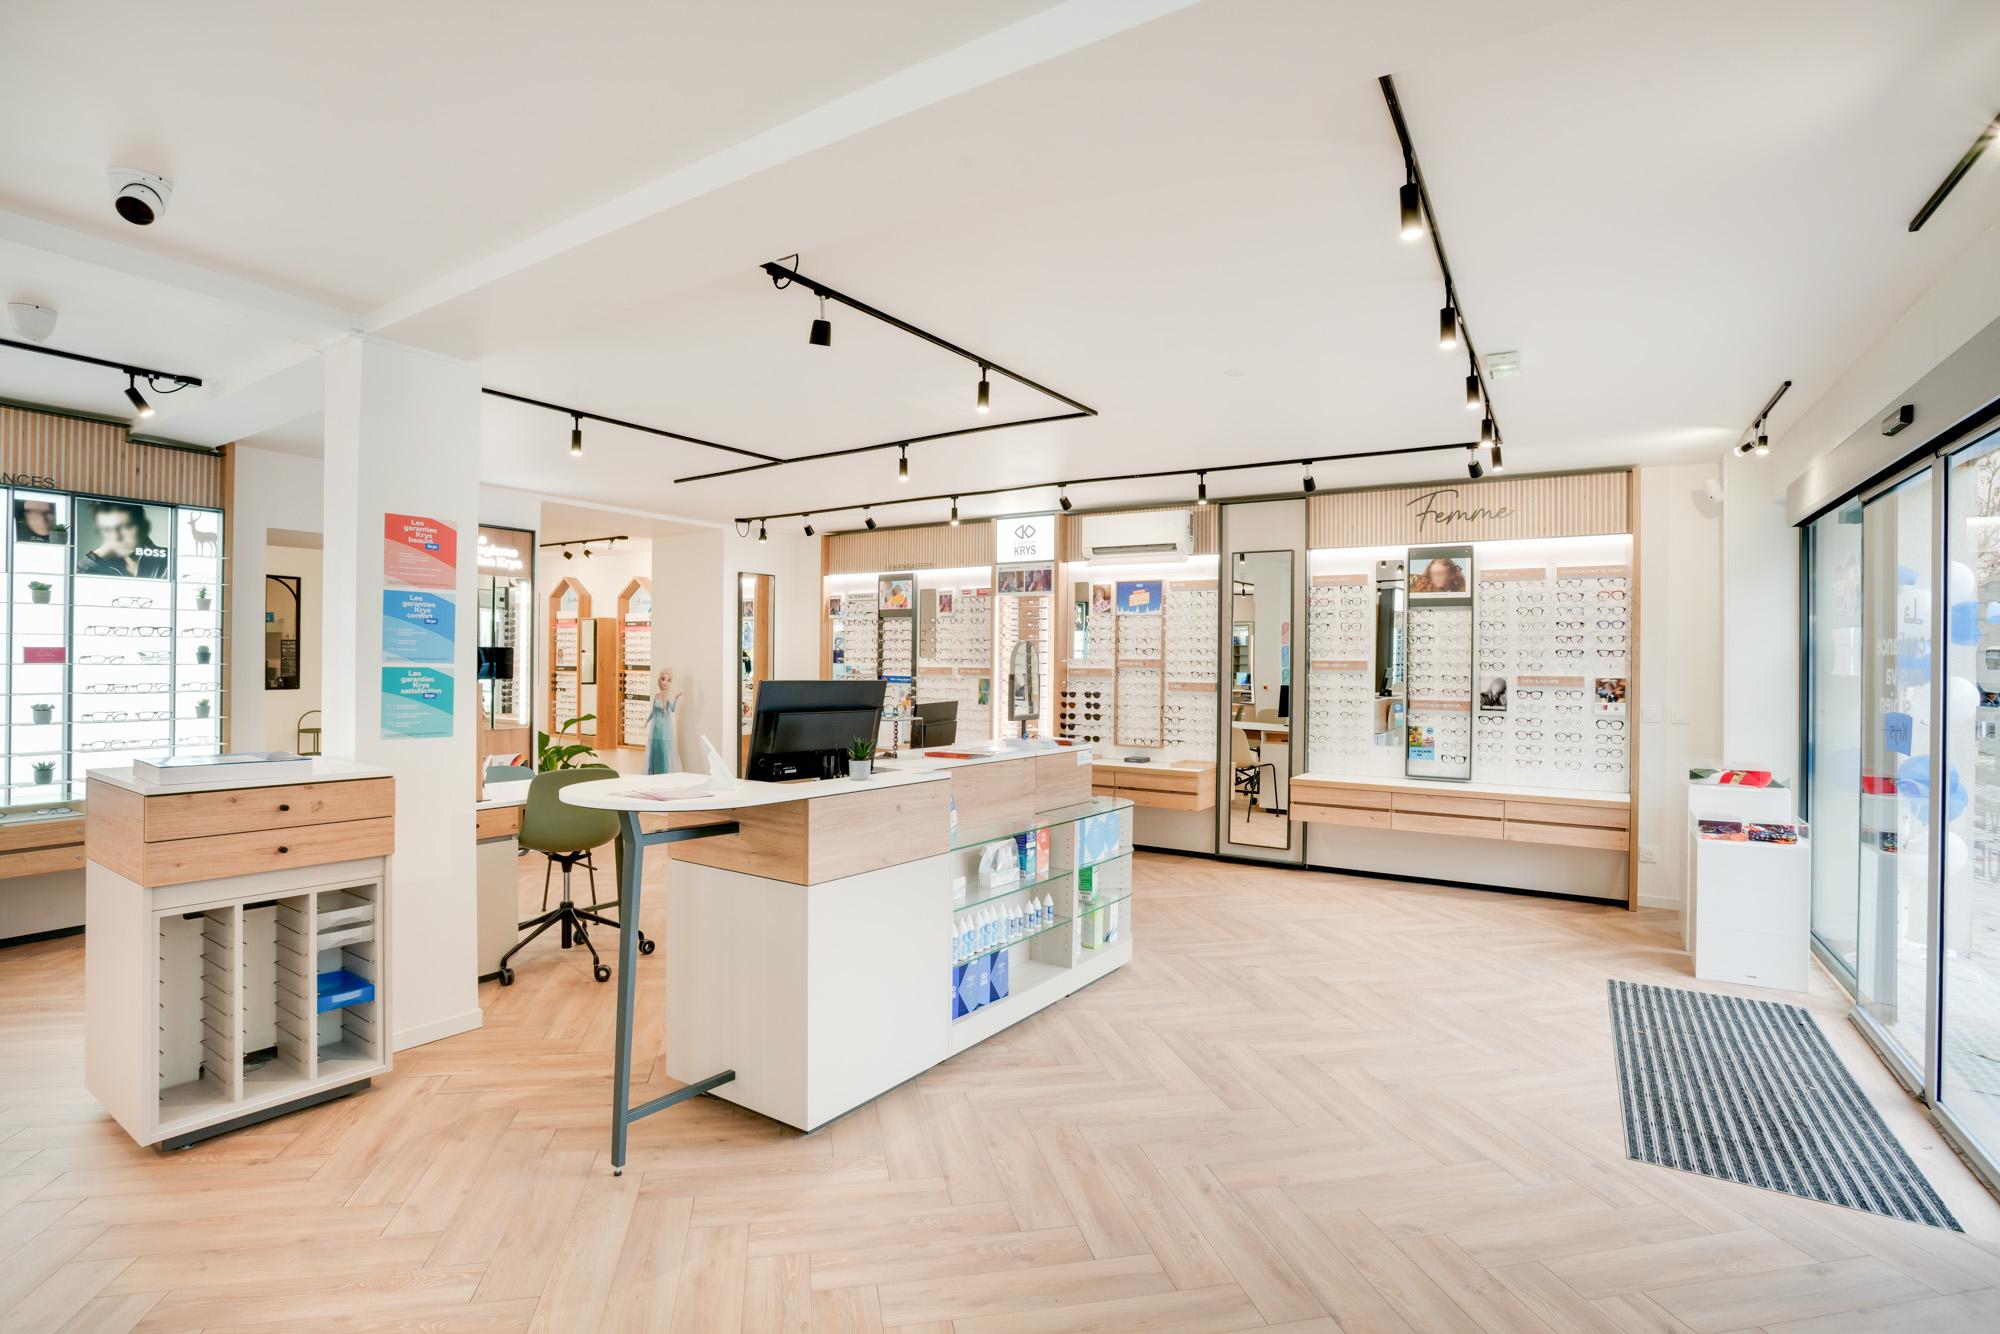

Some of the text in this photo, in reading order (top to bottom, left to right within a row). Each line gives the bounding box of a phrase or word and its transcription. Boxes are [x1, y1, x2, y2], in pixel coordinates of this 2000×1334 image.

[1404, 489, 1515, 533] Femme
[403, 525, 438, 533] garanties
[416, 531, 432, 540] Krys
[135, 547, 167, 558] BOSS
[1014, 544, 1036, 556] KRYS
[496, 556, 523, 570] Krys
[414, 606, 432, 614] Krys
[413, 682, 430, 690] Krys
